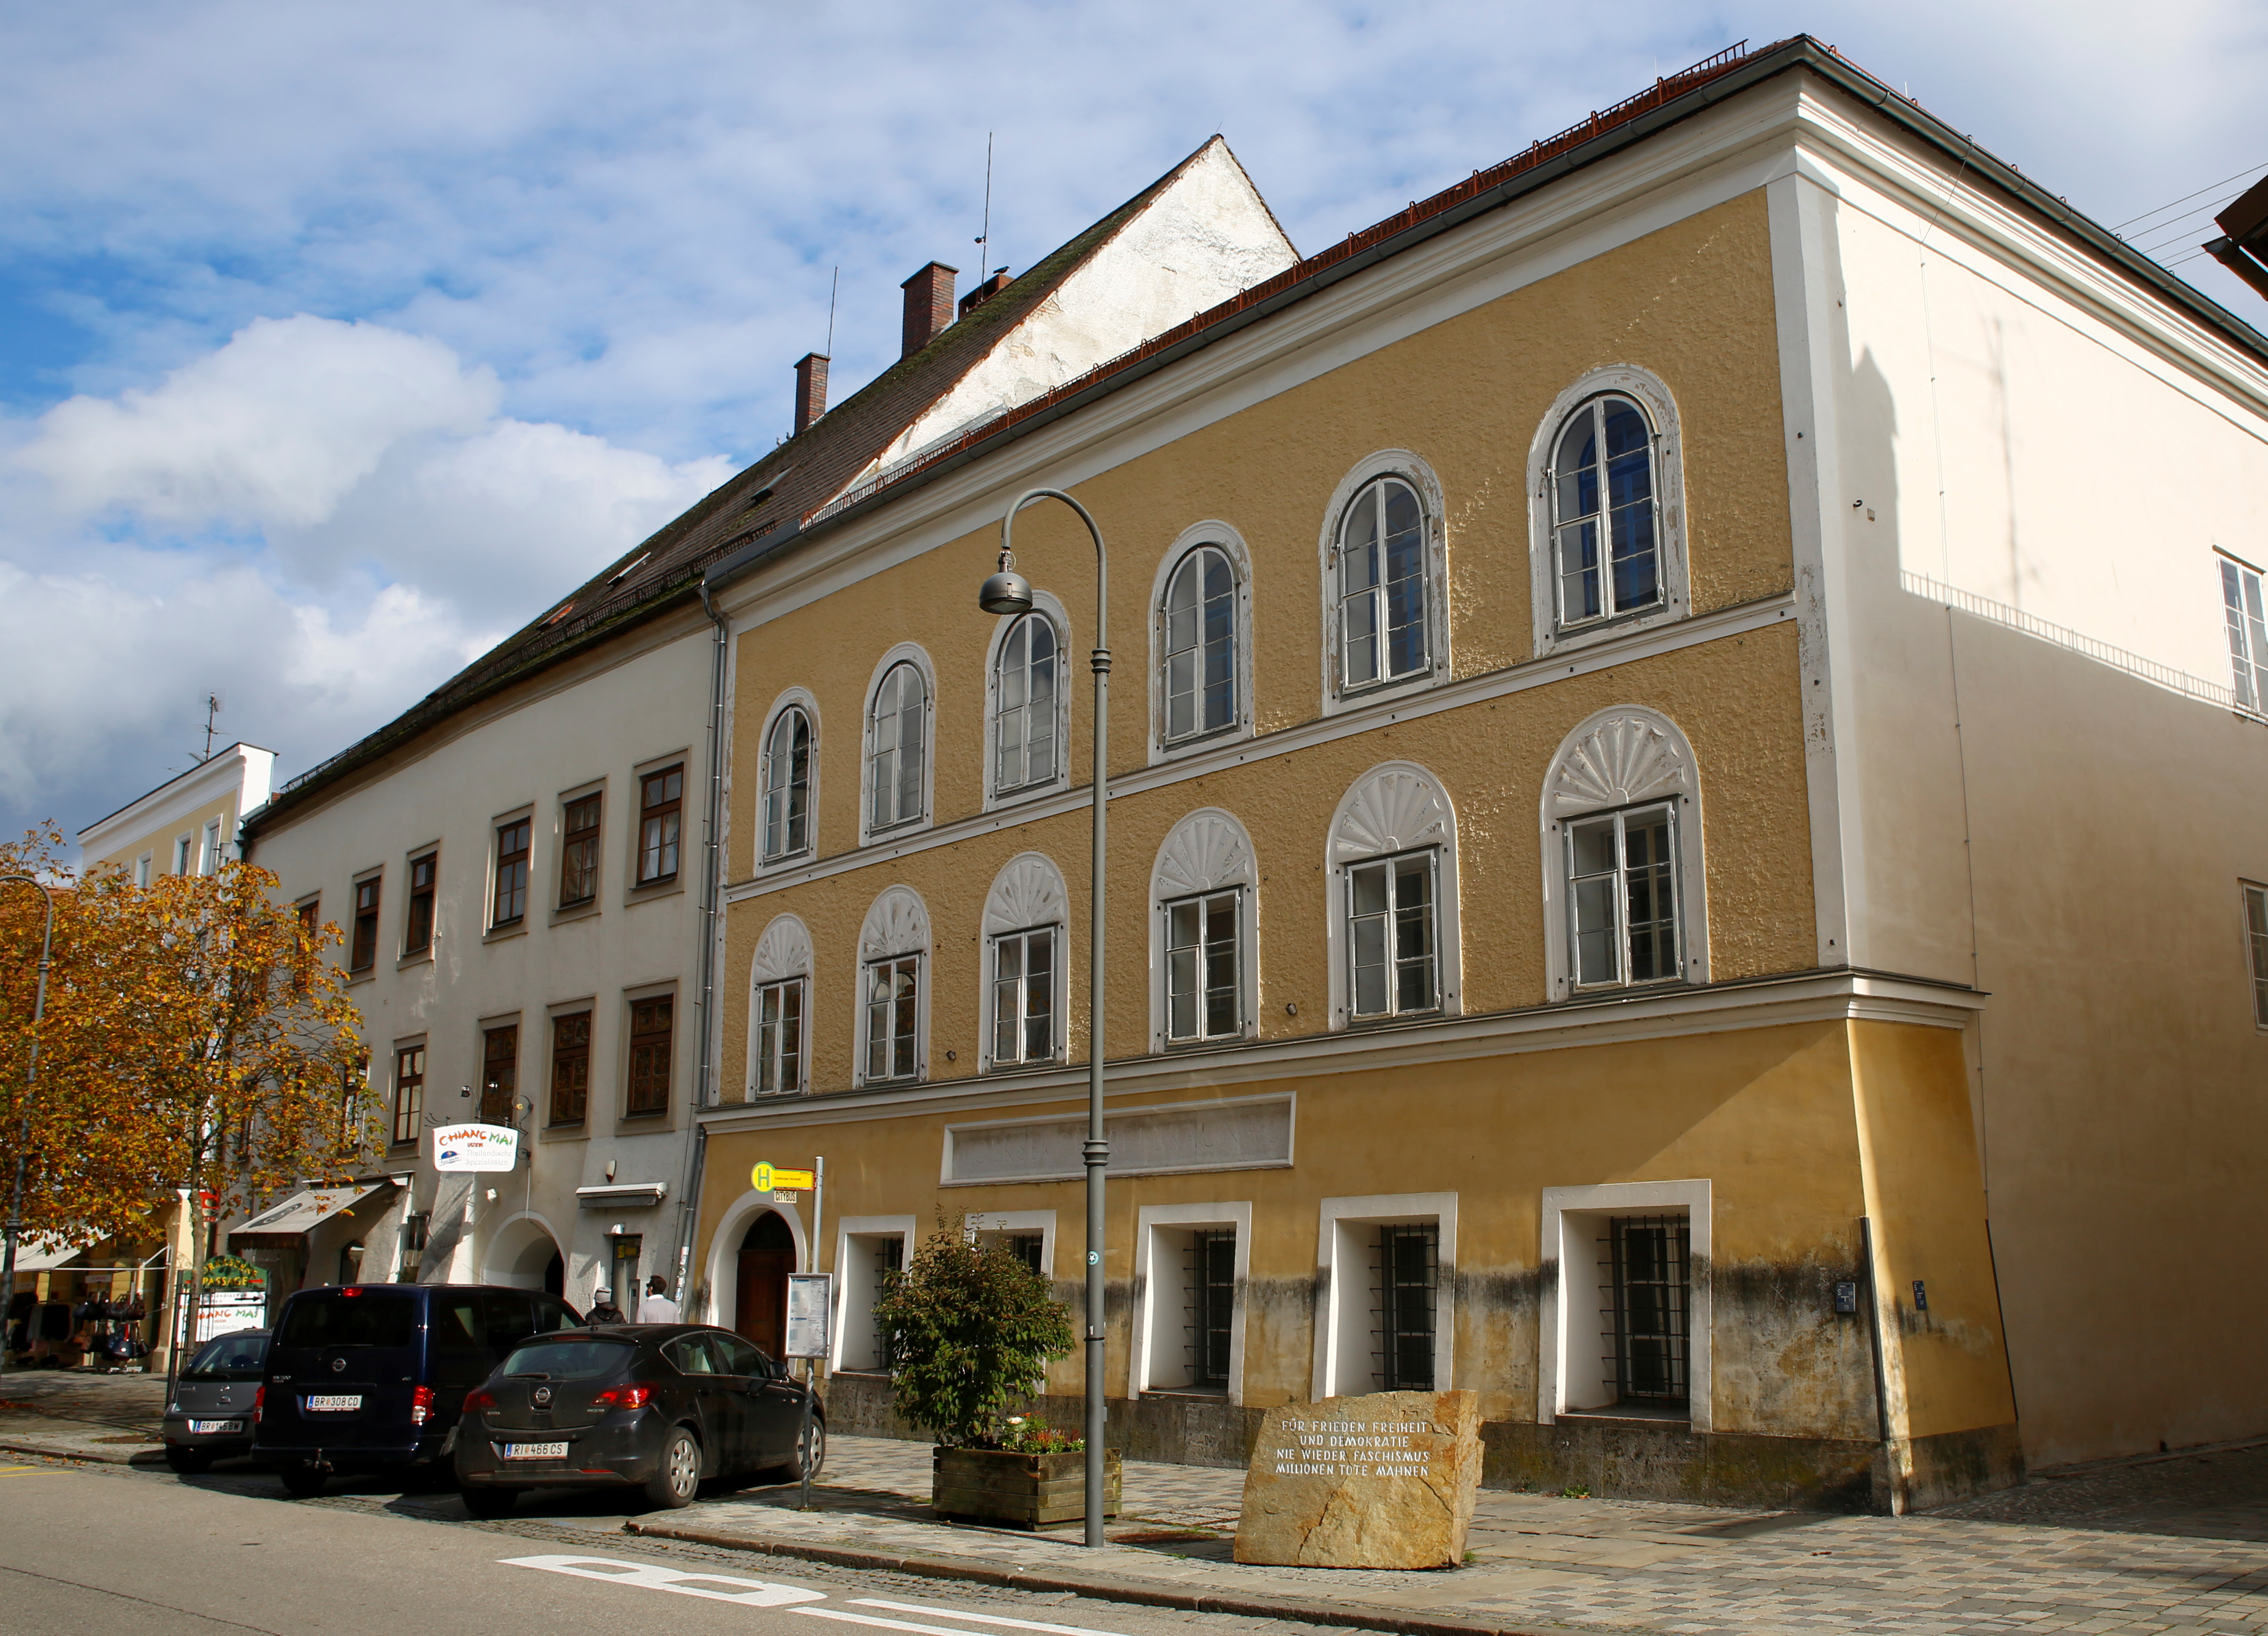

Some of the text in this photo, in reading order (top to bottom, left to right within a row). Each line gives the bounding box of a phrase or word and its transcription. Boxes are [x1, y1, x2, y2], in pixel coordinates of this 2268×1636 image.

[439, 1129, 513, 1146] CHIANG MAI
[758, 1168, 770, 1188] H
[776, 1191, 796, 1201] CITYBUS
[202, 1276, 248, 1285] PASSAGE
[235, 1309, 258, 1319] MAI
[314, 1397, 358, 1406] BR 308 CD
[201, 1422, 211, 1430] BR
[1282, 1418, 1427, 1433] FÜR FRIEDEN FREIHEIT
[1300, 1435, 1409, 1447] UND DEMOKRATIE
[514, 1444, 562, 1455] RI 466 CS
[1277, 1448, 1429, 1462] NIE WIEDER FASCHISMUS
[1275, 1463, 1429, 1477] MILLIONEN TOTE MAHNEN
